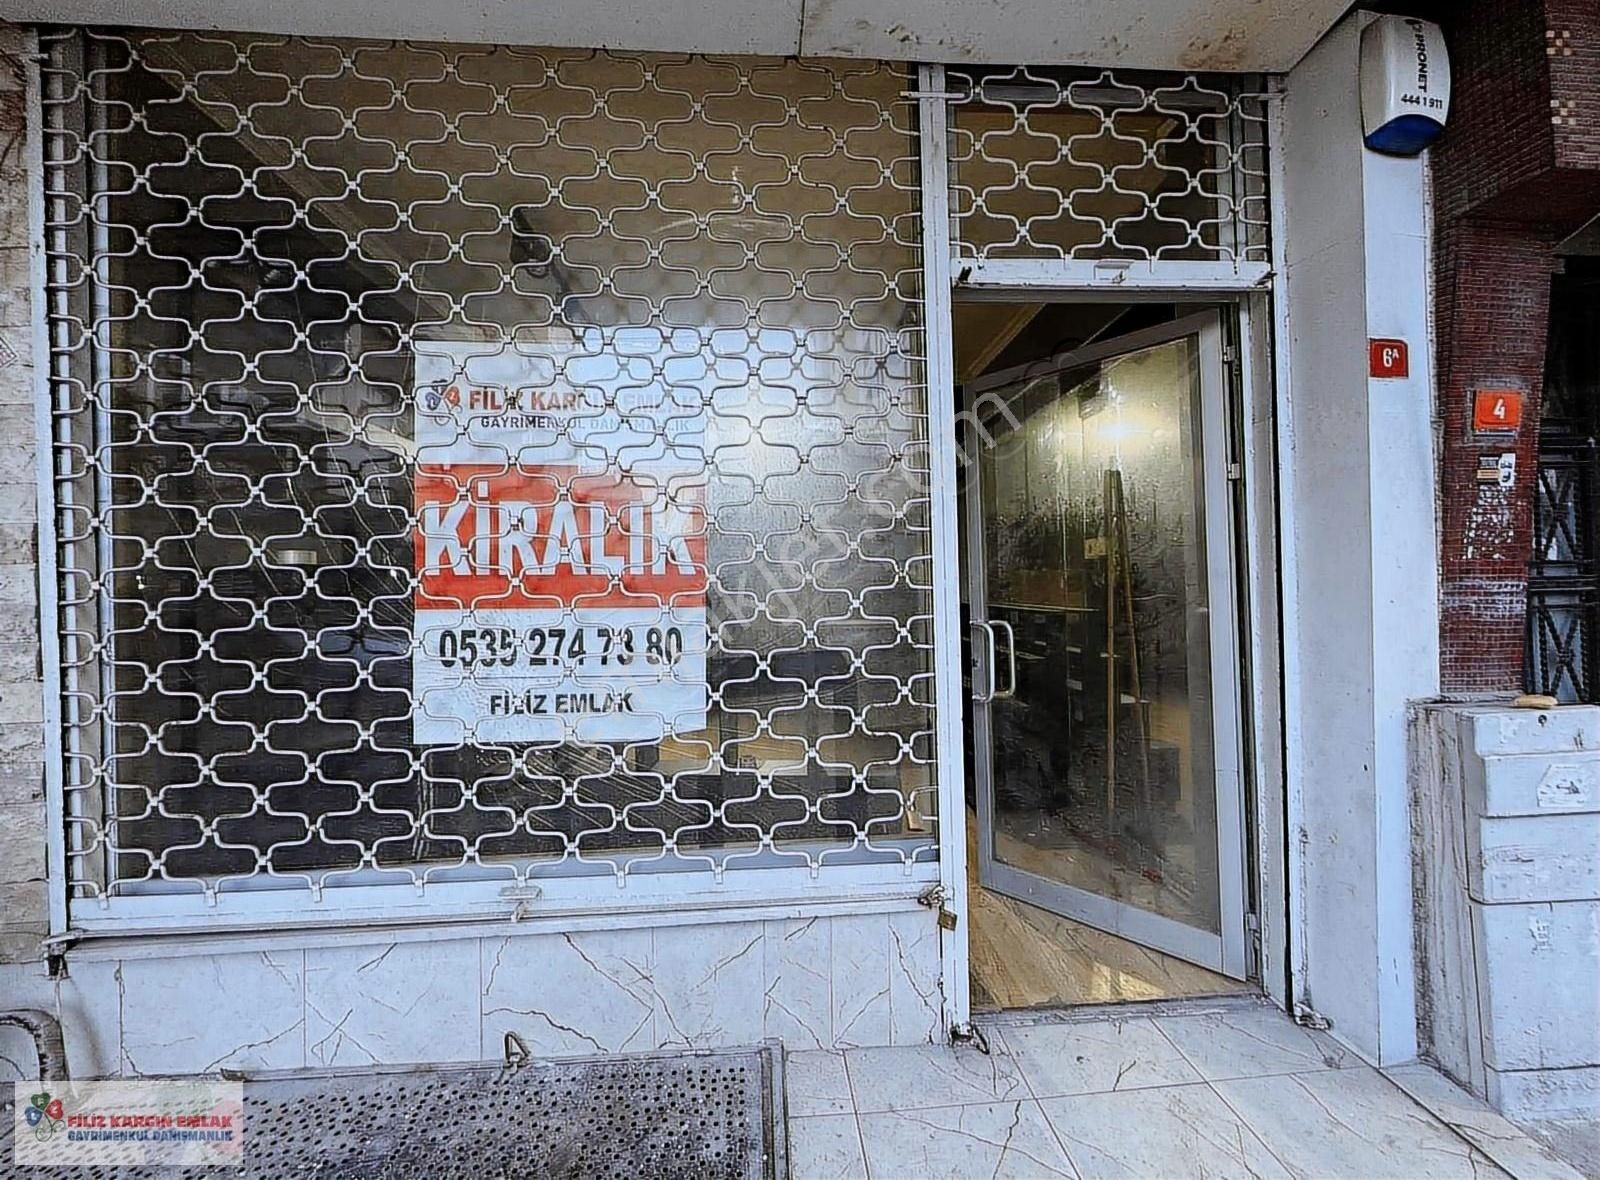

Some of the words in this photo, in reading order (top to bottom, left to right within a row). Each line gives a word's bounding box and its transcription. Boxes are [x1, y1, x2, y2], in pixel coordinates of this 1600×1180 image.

[1414, 33, 1428, 93] PRONET
[469, 386, 524, 410] FİL
[1493, 399, 1505, 419] 4
[425, 480, 696, 576] KİRALIK
[440, 629, 518, 667] 0535
[529, 628, 586, 666] 274
[597, 628, 634, 665] 73
[646, 626, 683, 665] 80
[555, 692, 633, 714] EMLAK
